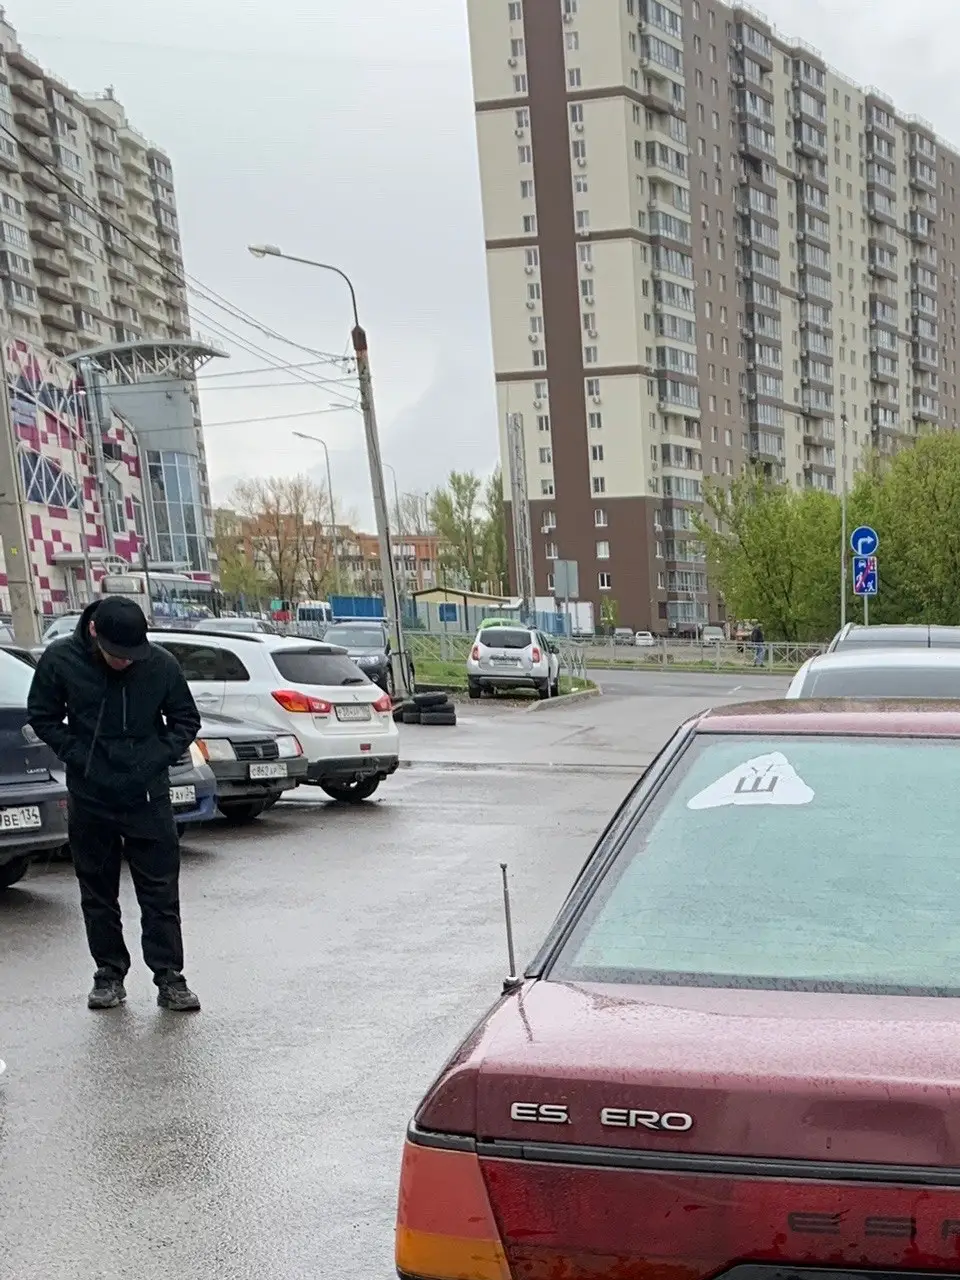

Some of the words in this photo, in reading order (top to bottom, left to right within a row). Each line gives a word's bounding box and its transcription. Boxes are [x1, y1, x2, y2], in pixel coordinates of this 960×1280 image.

[0, 814, 19, 827] ВЕ
[20, 808, 39, 821] 134
[510, 1102, 568, 1123] ES
[600, 1107, 693, 1131] ERO
